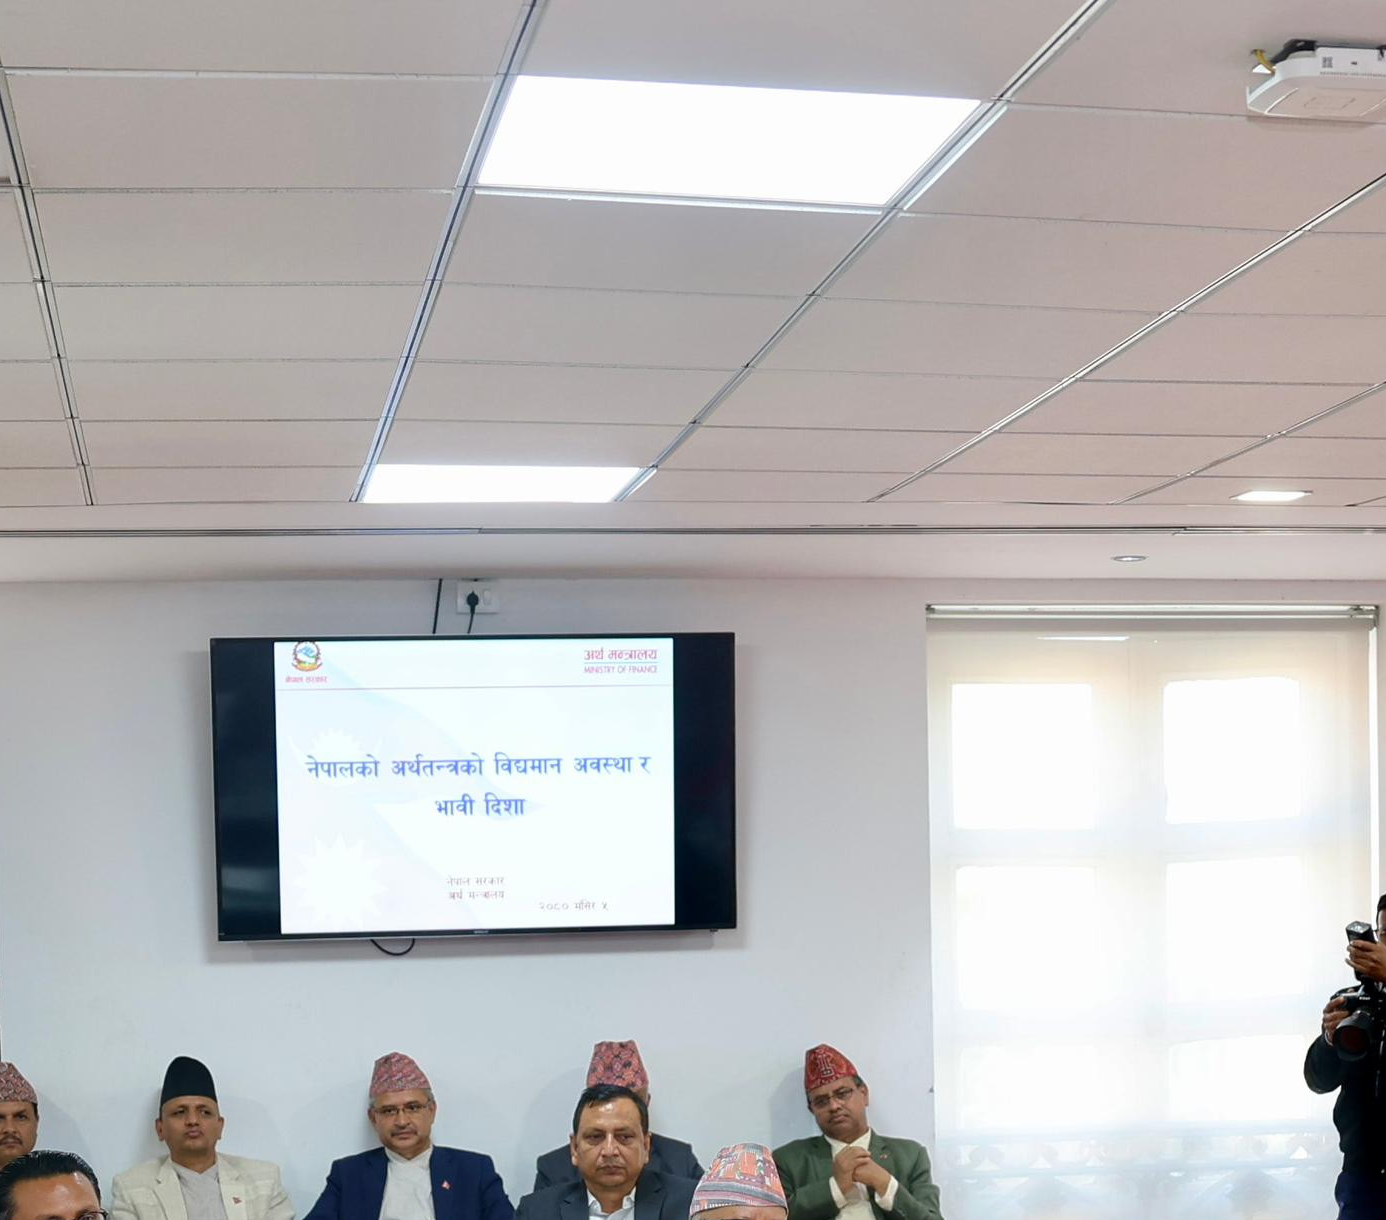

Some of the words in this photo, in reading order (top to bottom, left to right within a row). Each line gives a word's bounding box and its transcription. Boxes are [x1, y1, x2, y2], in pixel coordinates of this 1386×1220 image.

[584, 648, 604, 661] अर्थ
[608, 647, 657, 661] मन्त्रालय
[584, 664, 616, 674] MINISTRY
[618, 664, 627, 674] OF
[629, 664, 658, 674] FINANCE
[306, 754, 380, 778] नेपालको
[392, 753, 483, 777] अर्थतन्त्रको
[495, 752, 562, 775] विद्यमान
[574, 756, 632, 775] अवस्था
[640, 756, 652, 775] र
[436, 793, 473, 817] भावी
[485, 793, 525, 816] दिशा
